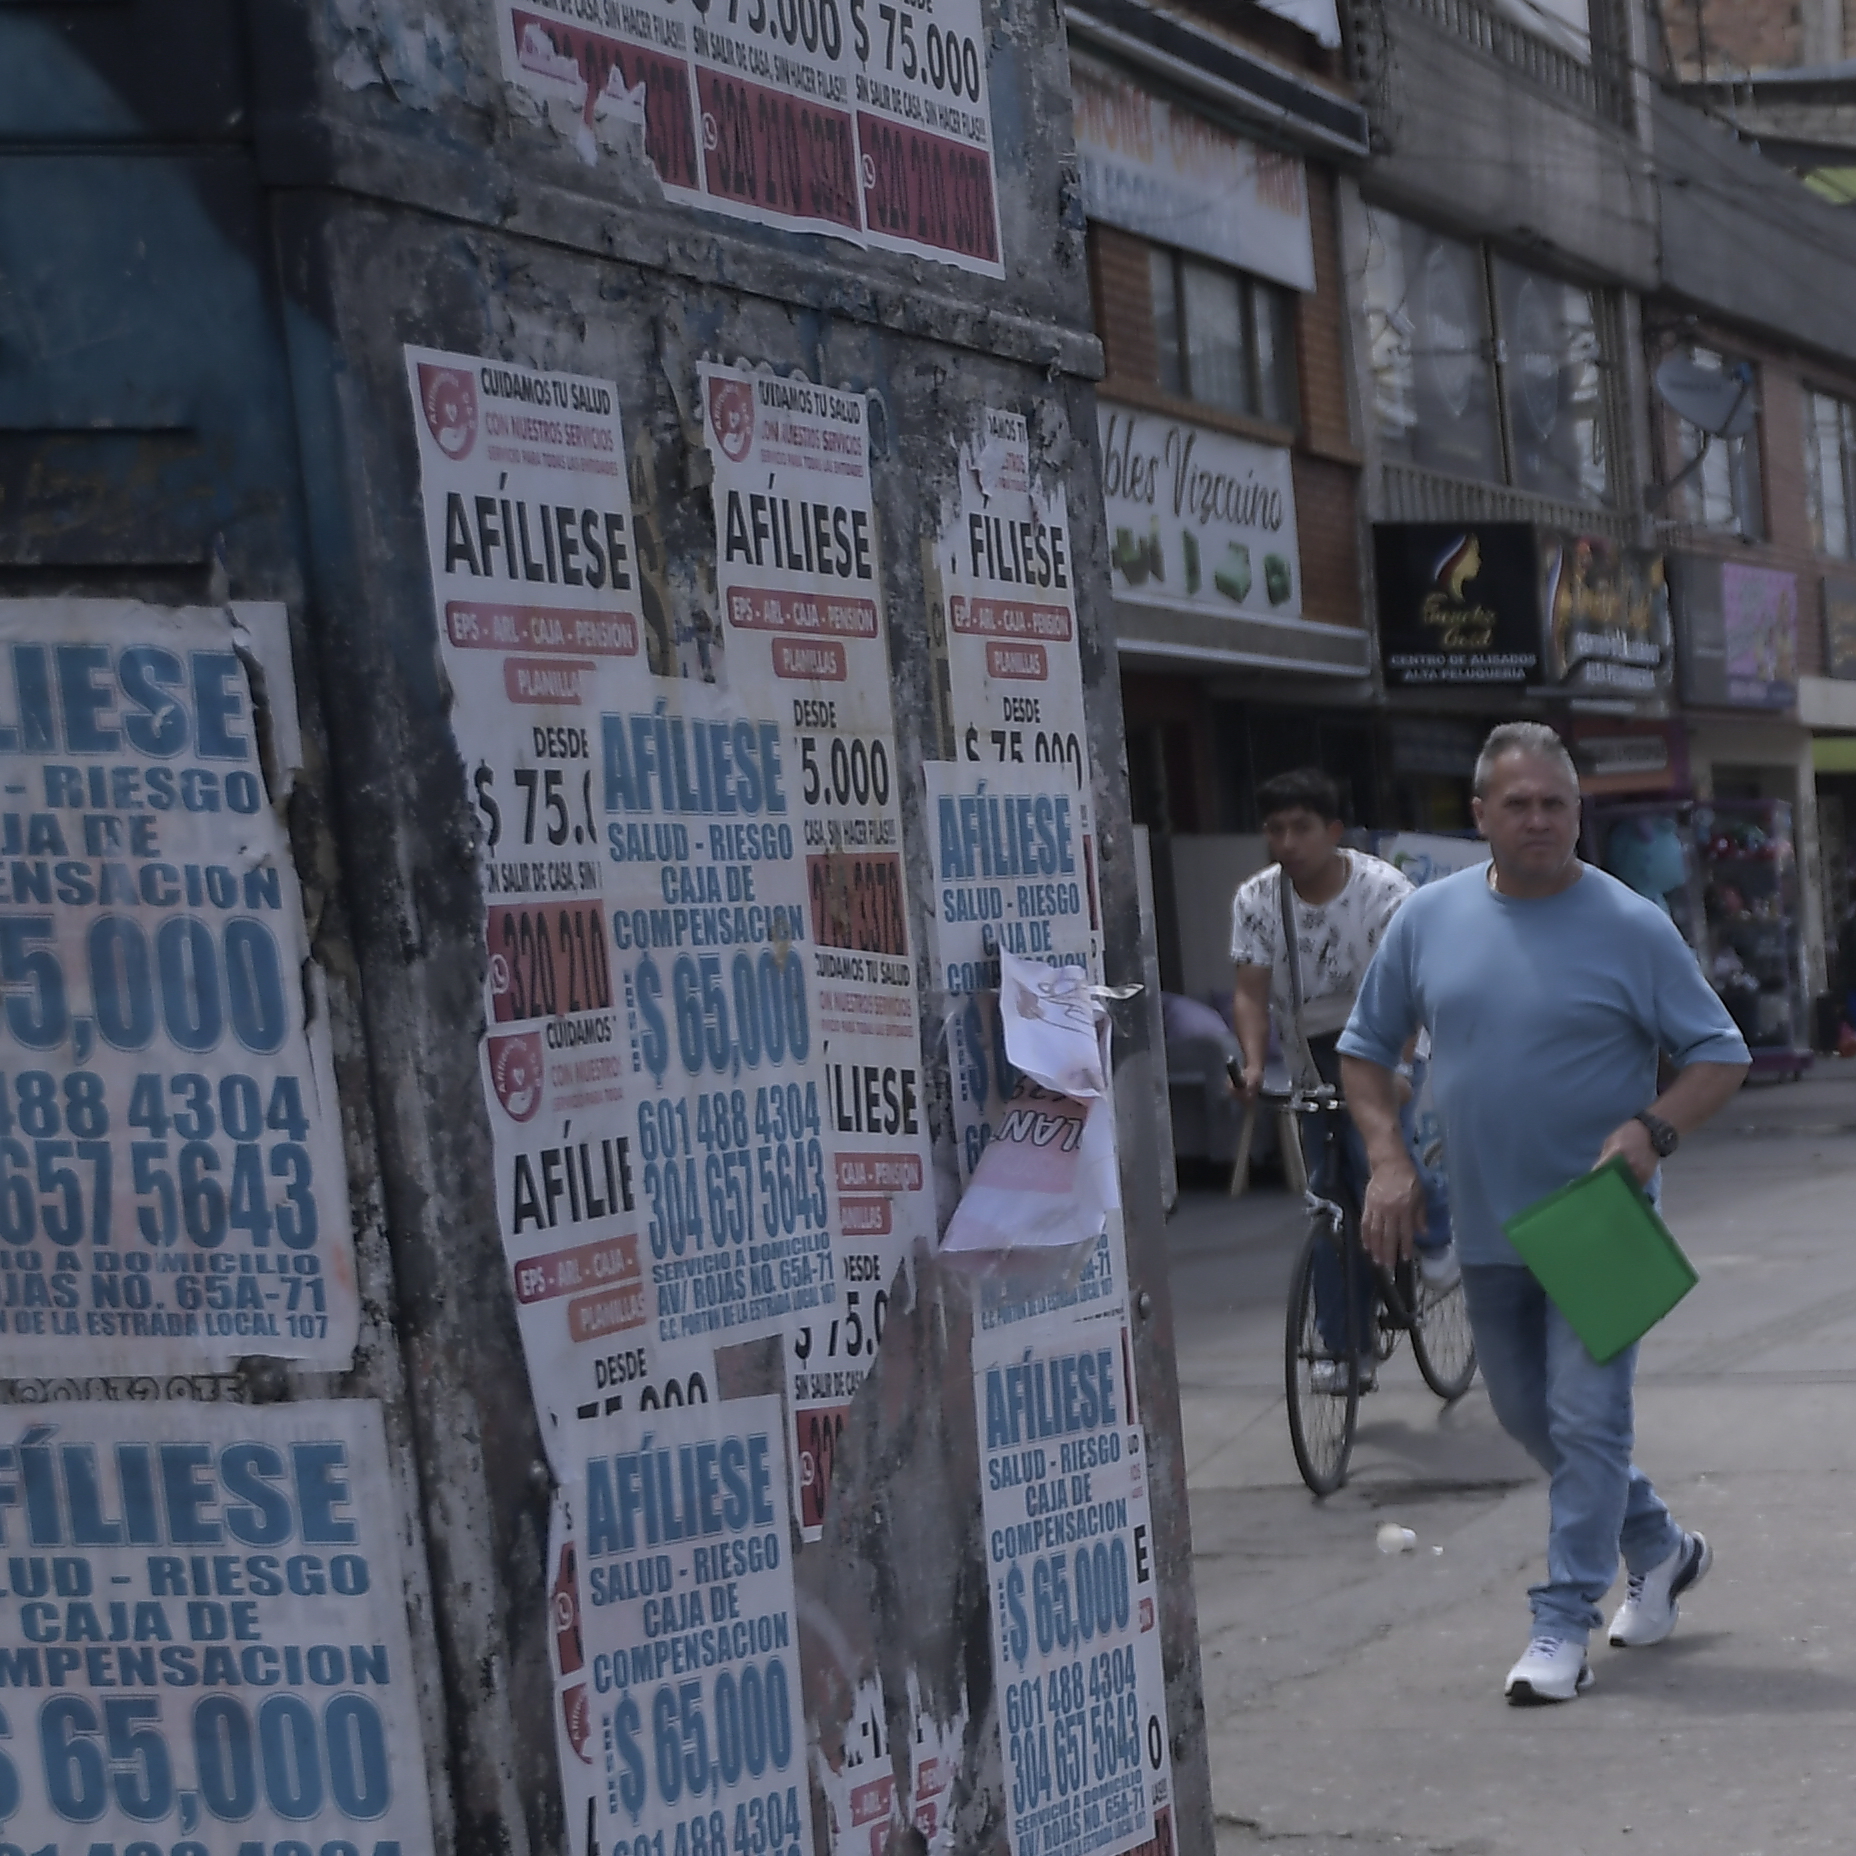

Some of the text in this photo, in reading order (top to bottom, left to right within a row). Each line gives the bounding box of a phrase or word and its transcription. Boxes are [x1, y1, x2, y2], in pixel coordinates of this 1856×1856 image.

[879, 4, 980, 103] 75.000
[481, 367, 611, 416] CUIDAMOS TU SALUD
[829, 395, 861, 425] SALUD
[486, 412, 508, 438] CON
[510, 416, 564, 447] NUESTROS
[446, 472, 631, 590] AFÍLIESE
[725, 472, 873, 579] AFÍLIESE
[454, 611, 478, 640] EPS
[531, 617, 564, 645] CAJA
[793, 699, 837, 729] DESDE
[1003, 696, 1041, 724] DESDE
[533, 726, 589, 758] DESDE
[600, 696, 788, 817] AFÍLIESE
[43, 764, 261, 814] RIESGO
[84, 814, 161, 858] DE
[608, 822, 793, 862] SALUD RIESGO
[938, 779, 1076, 882] AFÍLIESE
[661, 865, 756, 905] CAJA DE
[943, 882, 1080, 923] SALUD RIESGO
[613, 904, 805, 951] COMPENSACION
[1029, 920, 1052, 952] DE
[546, 1016, 612, 1050] CUIDAMOS
[672, 947, 811, 1084] 65,000
[128, 1072, 311, 1143] 4304
[637, 1096, 693, 1162] 601
[697, 1089, 750, 1151] 488
[755, 1081, 821, 1144] 4304
[131, 1141, 321, 1251] 5643
[644, 1137, 828, 1260] 304 657 5643
[56, 1250, 322, 1275] A DOMICILIO
[652, 1231, 831, 1284] SERVICIO DOMICILIO
[92, 1273, 328, 1312] NO. 65A-71
[15, 1312, 328, 1340] DE LA ESTRADA LOCAL 107
[595, 1347, 648, 1390] DESDE
[986, 1346, 1116, 1451] AFÍLIESE
[989, 1432, 1121, 1491] SALUD RIESGO
[586, 1431, 774, 1560] AFÍLIESE
[1025, 1473, 1092, 1517] CAJA DE
[991, 1498, 1128, 1563] COMPENSACION
[147, 1554, 371, 1597] RIESGO
[590, 1533, 780, 1606] SALUD RIESGO
[21, 1600, 263, 1643] CAJA DE
[643, 1583, 739, 1638] CAJA DE
[593, 1612, 789, 1694] COMPENSACION
[1005, 1643, 1136, 1734] 601 488 4304
[653, 1655, 791, 1806] 65,000
[1009, 1693, 1141, 1815] 304 657 5643
[41, 1692, 394, 1836] 65,000
